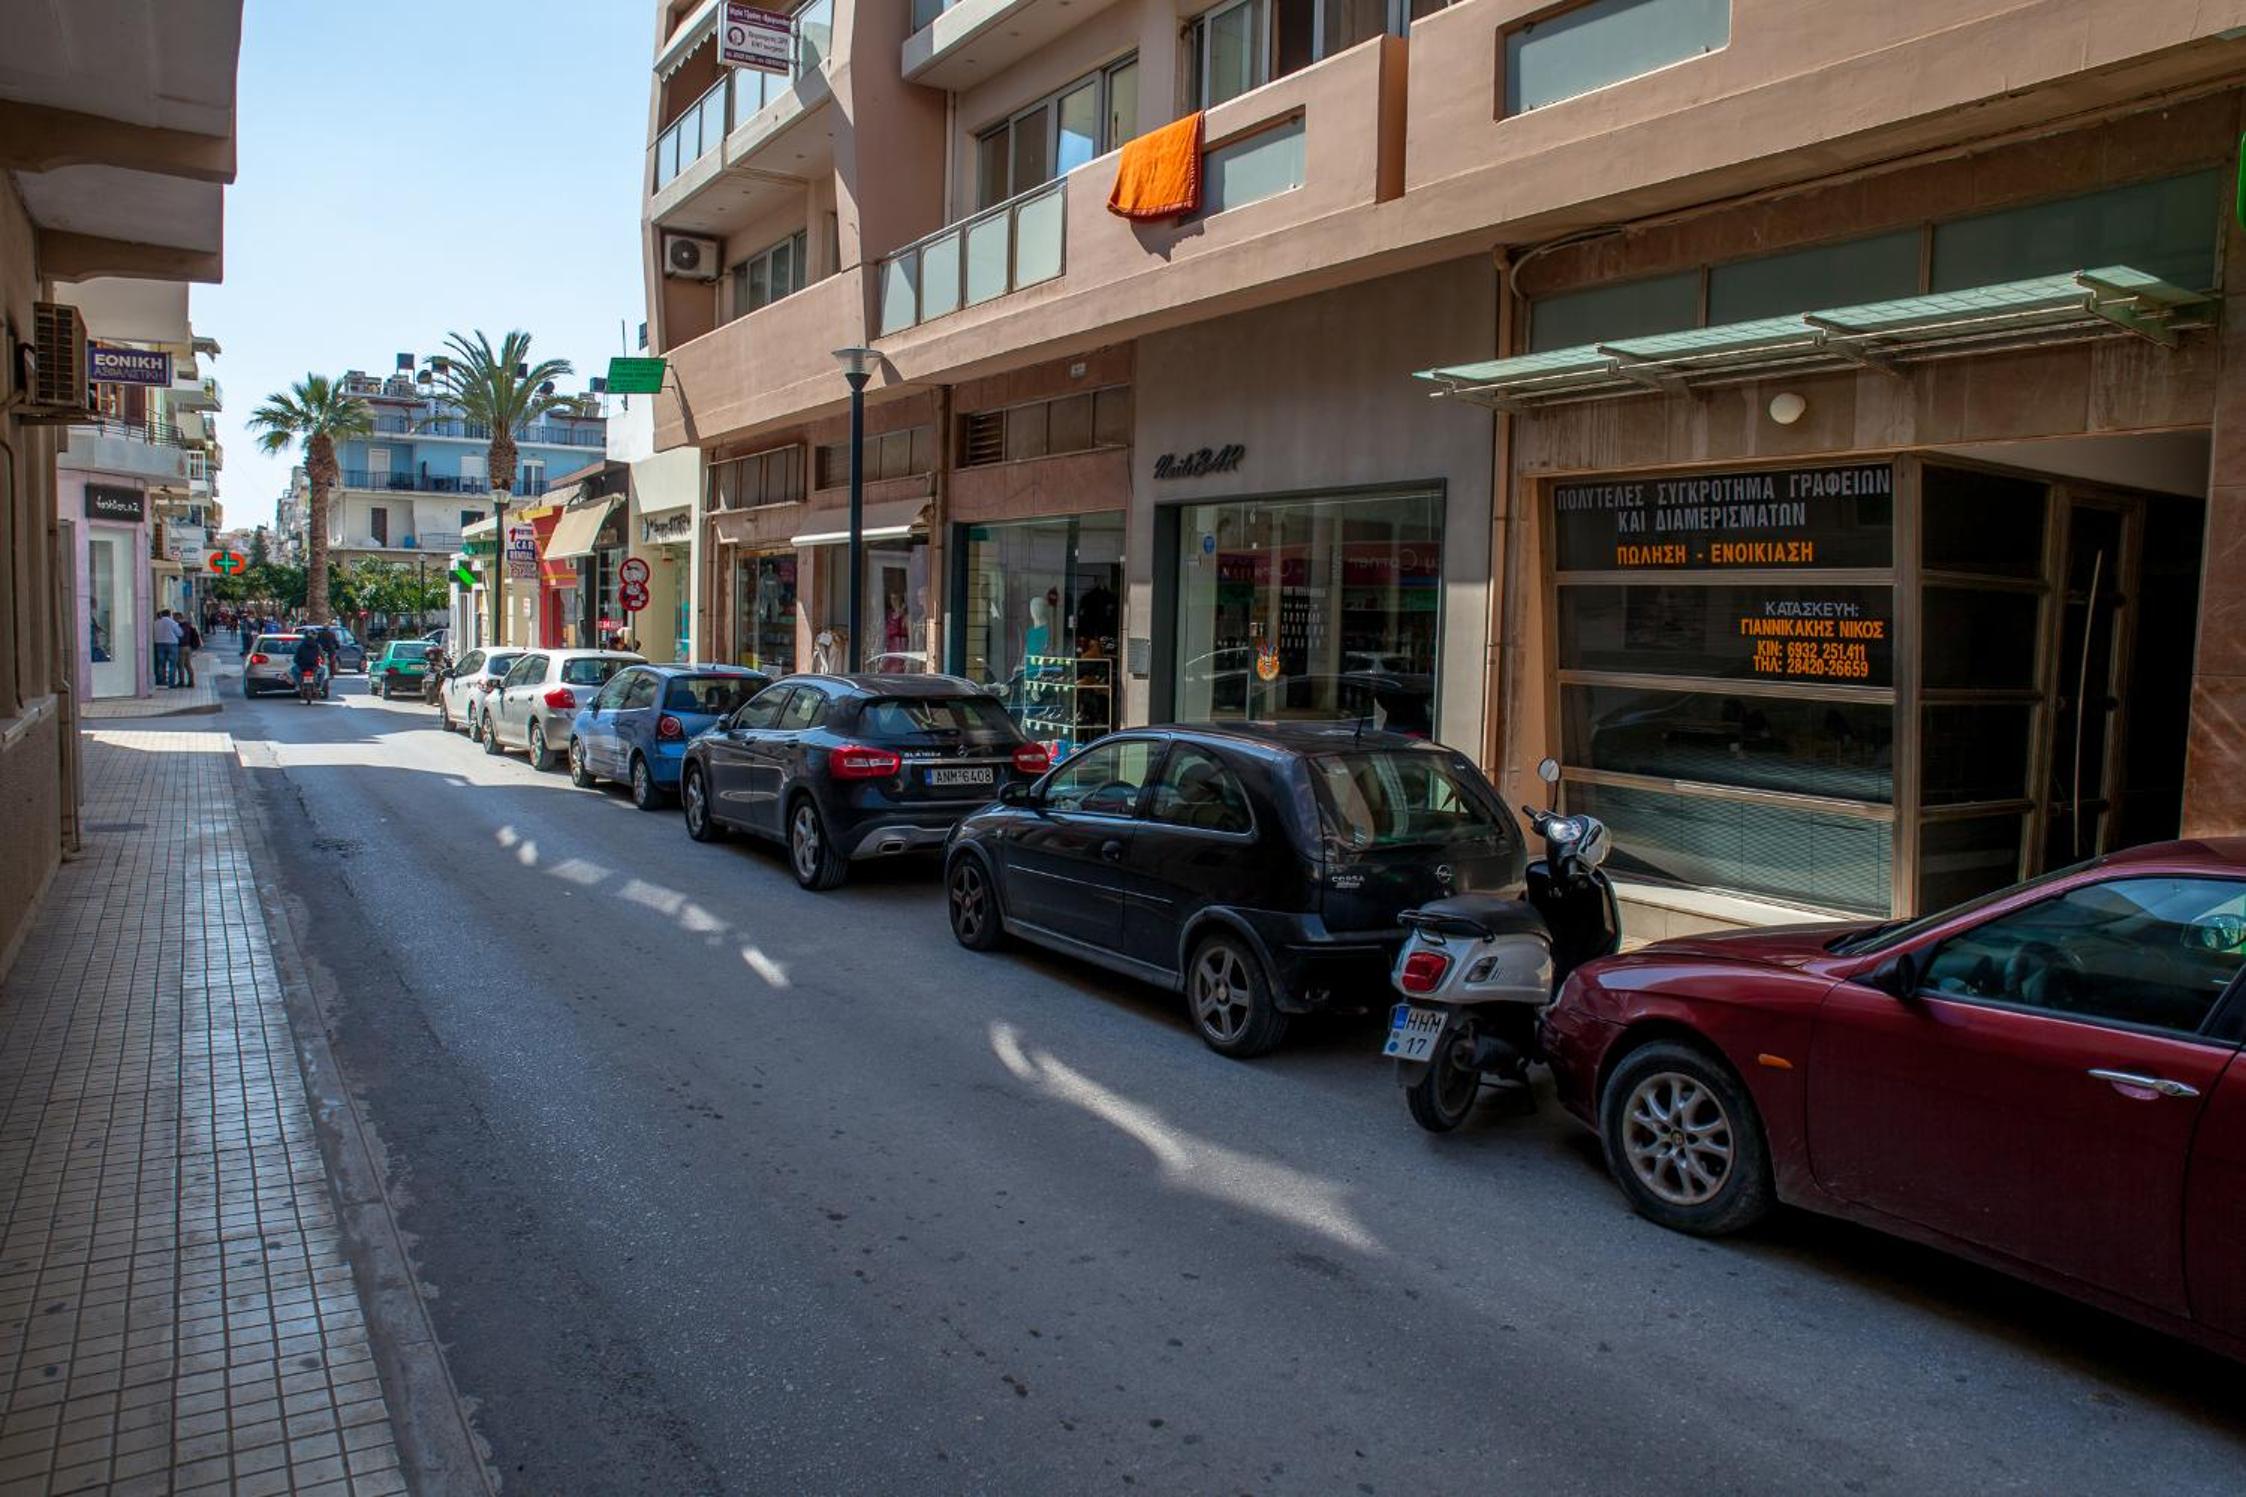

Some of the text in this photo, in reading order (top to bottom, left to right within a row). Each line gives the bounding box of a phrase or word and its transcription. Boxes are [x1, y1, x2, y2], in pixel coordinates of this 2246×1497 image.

[1557, 468, 1890, 510] ΠΟΛΥΤΕΛΕΣ ΣΥΓΚΡΟΤΗΜΑ ΓΡΑΦΕΙΩΝ
[1617, 502, 1806, 533] ΚΑΙ ΔΙΑΜΕΡΙΣΜΑΤΩΝ
[516, 540, 535, 550] CAR
[1617, 544, 1686, 565] ΠΩΛΗΣΗ
[1711, 541, 1814, 563] ΕΝΟΙΚΙΑΣΗ
[1765, 601, 1859, 617] ΚΑΤΑΣΚΕΥΗ:
[1741, 618, 1885, 639] ΓΙΑΝΝΙΚΑΚΗΣ ΝΙΚΟΣ
[1757, 640, 1783, 657] ΚΙΝ:
[1787, 641, 1818, 659] 6932
[1753, 656, 1870, 678] ΤΗΛ: 28420-26659
[1407, 1037, 1428, 1055] 17
